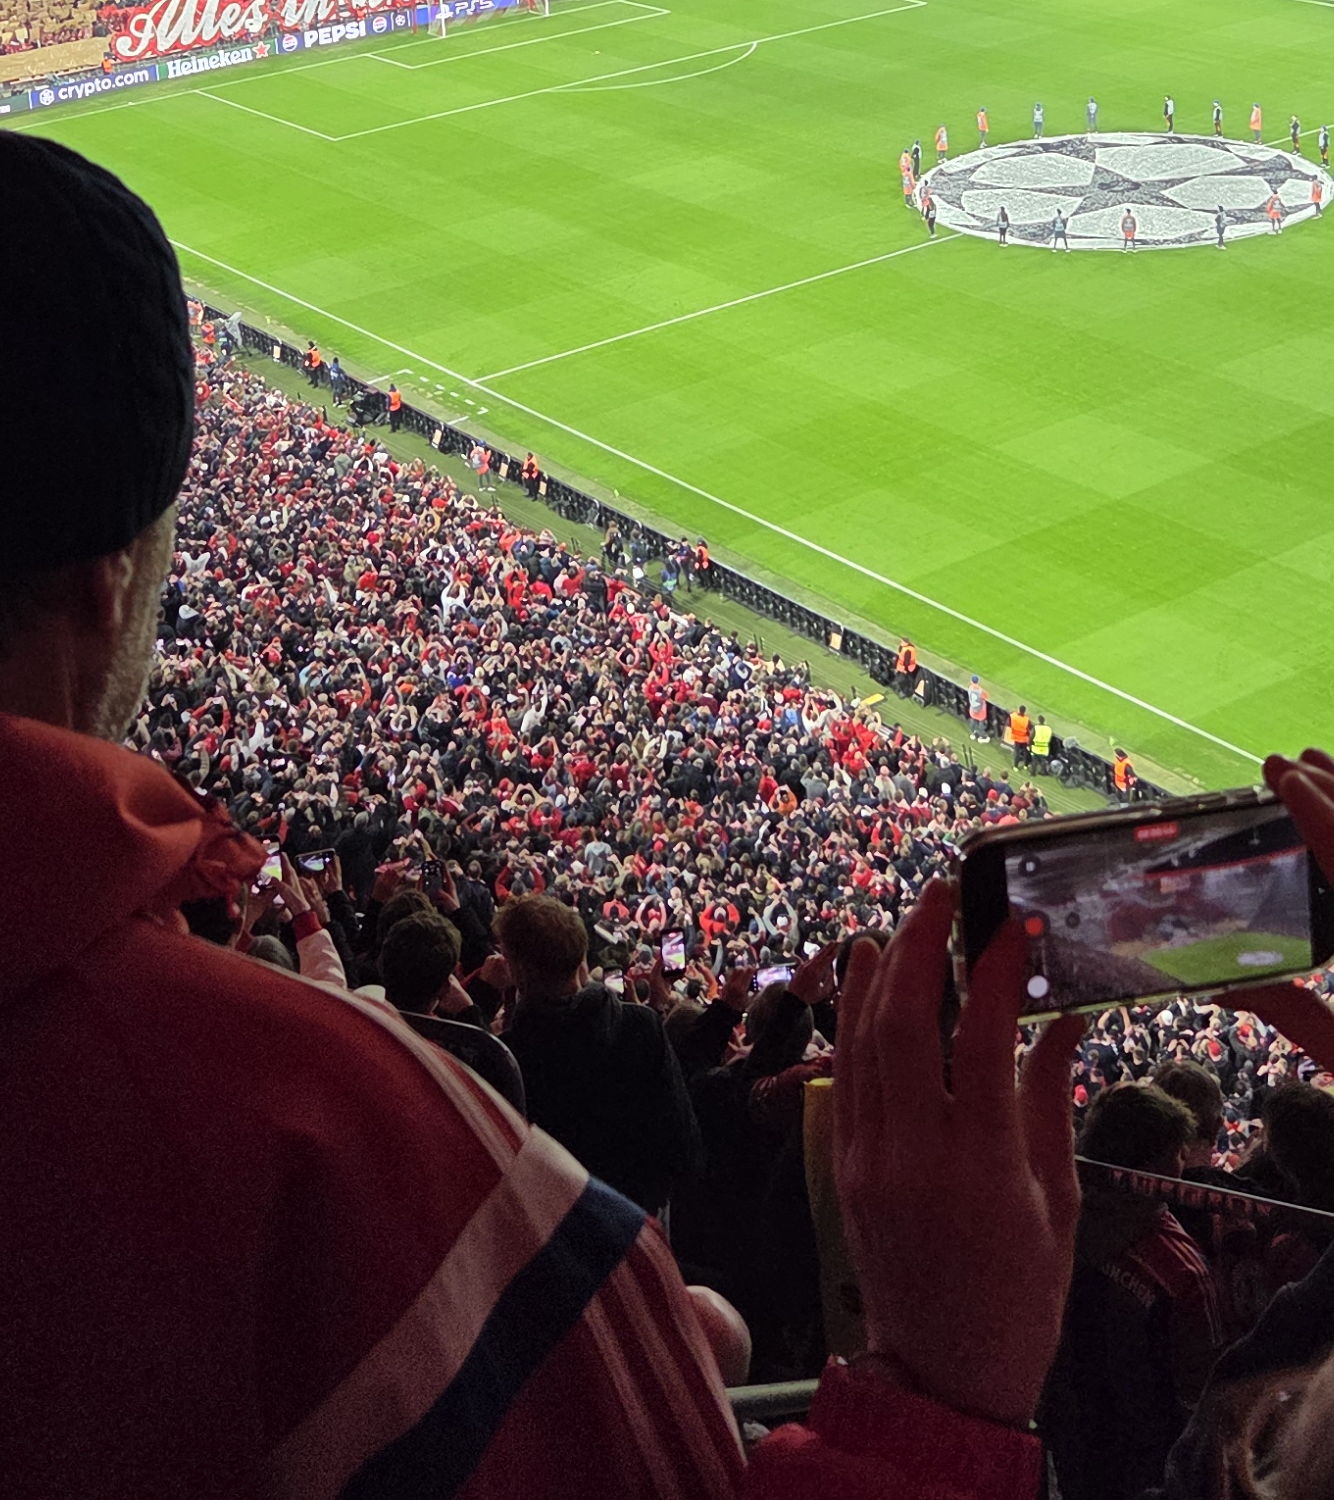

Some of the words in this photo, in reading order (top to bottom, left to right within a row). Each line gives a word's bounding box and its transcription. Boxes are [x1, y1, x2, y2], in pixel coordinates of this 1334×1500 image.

[304, 20, 367, 49] PEPSI
[167, 47, 253, 80] Heineken
[57, 68, 149, 101] crypto.com
